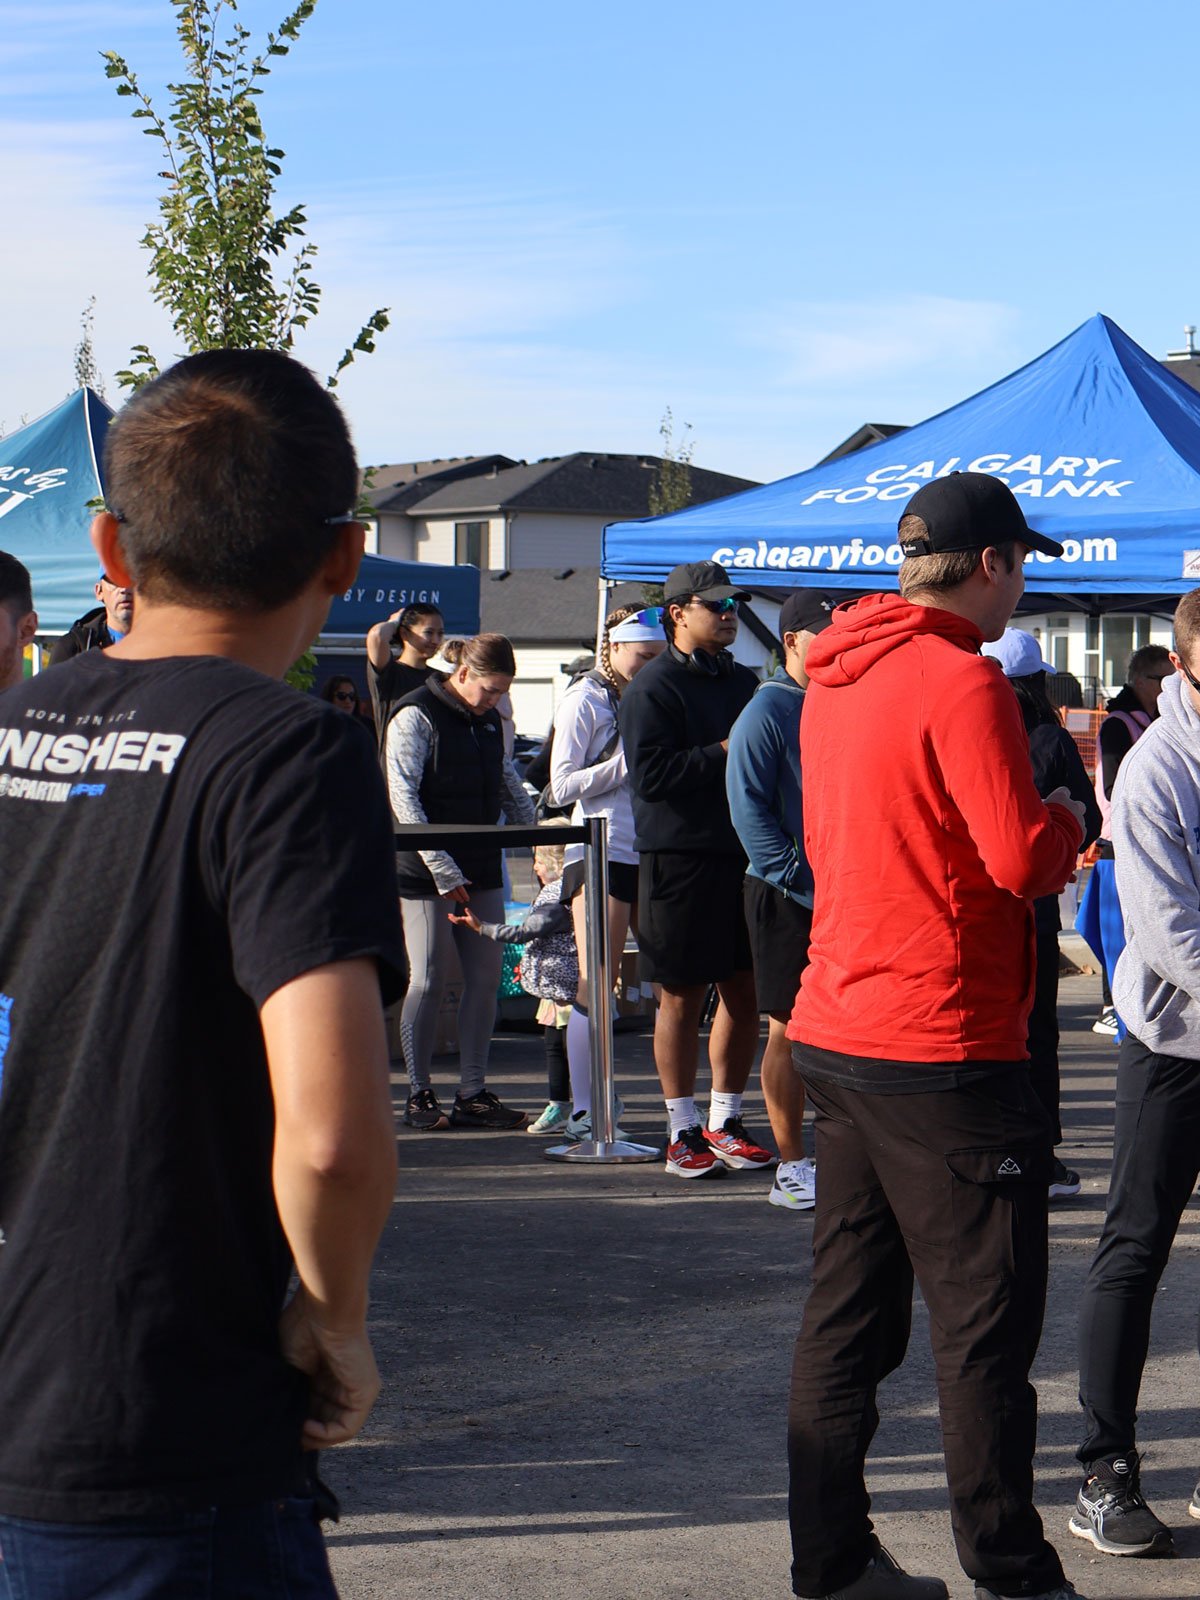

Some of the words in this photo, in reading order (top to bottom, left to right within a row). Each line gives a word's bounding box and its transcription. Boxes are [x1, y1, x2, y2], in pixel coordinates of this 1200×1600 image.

[865, 453, 1122, 484] CALGARY
[800, 482, 919, 506] FOO
[343, 588, 365, 602] BY
[375, 589, 440, 604] DESIGN
[0, 728, 187, 774] NISHER
[8, 776, 72, 802] SPARTAN
